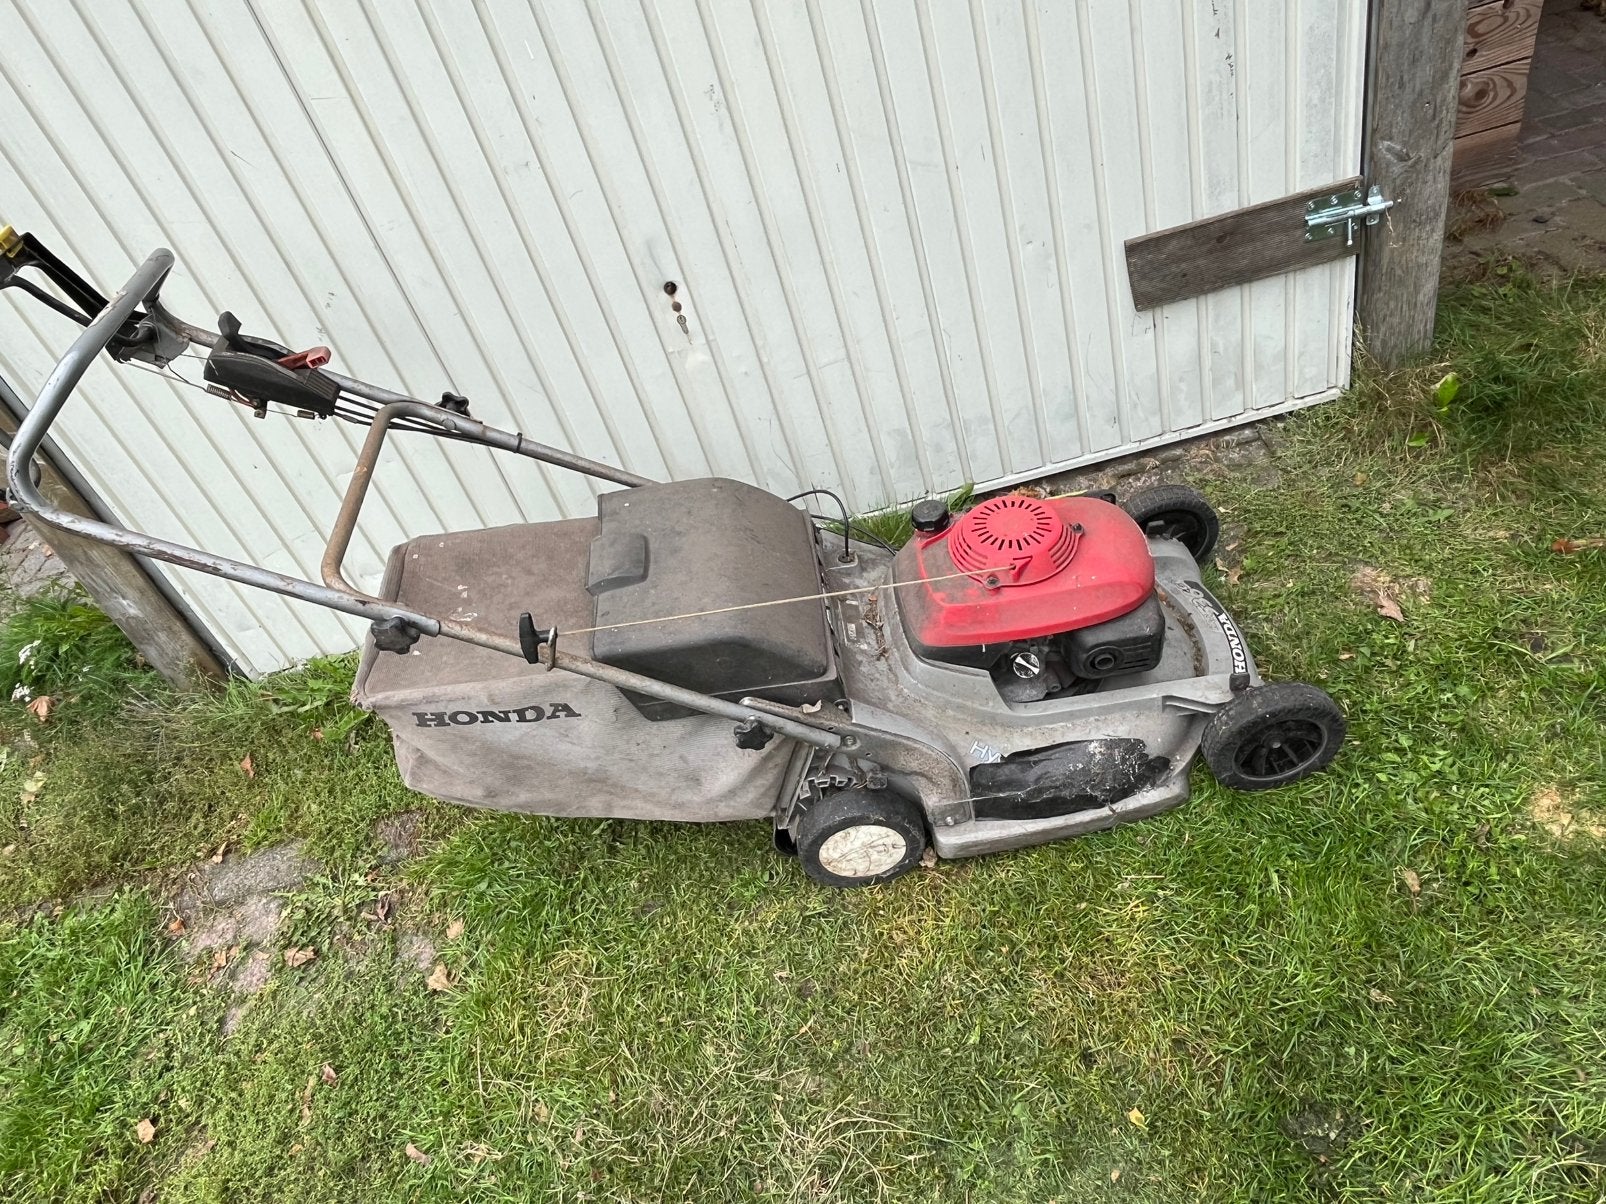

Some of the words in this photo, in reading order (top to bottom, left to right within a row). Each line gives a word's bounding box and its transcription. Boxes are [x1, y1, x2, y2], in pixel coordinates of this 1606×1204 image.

[1217, 612, 1246, 674] HONDA
[412, 702, 582, 728] HONDA
[969, 740, 1001, 764] HY
